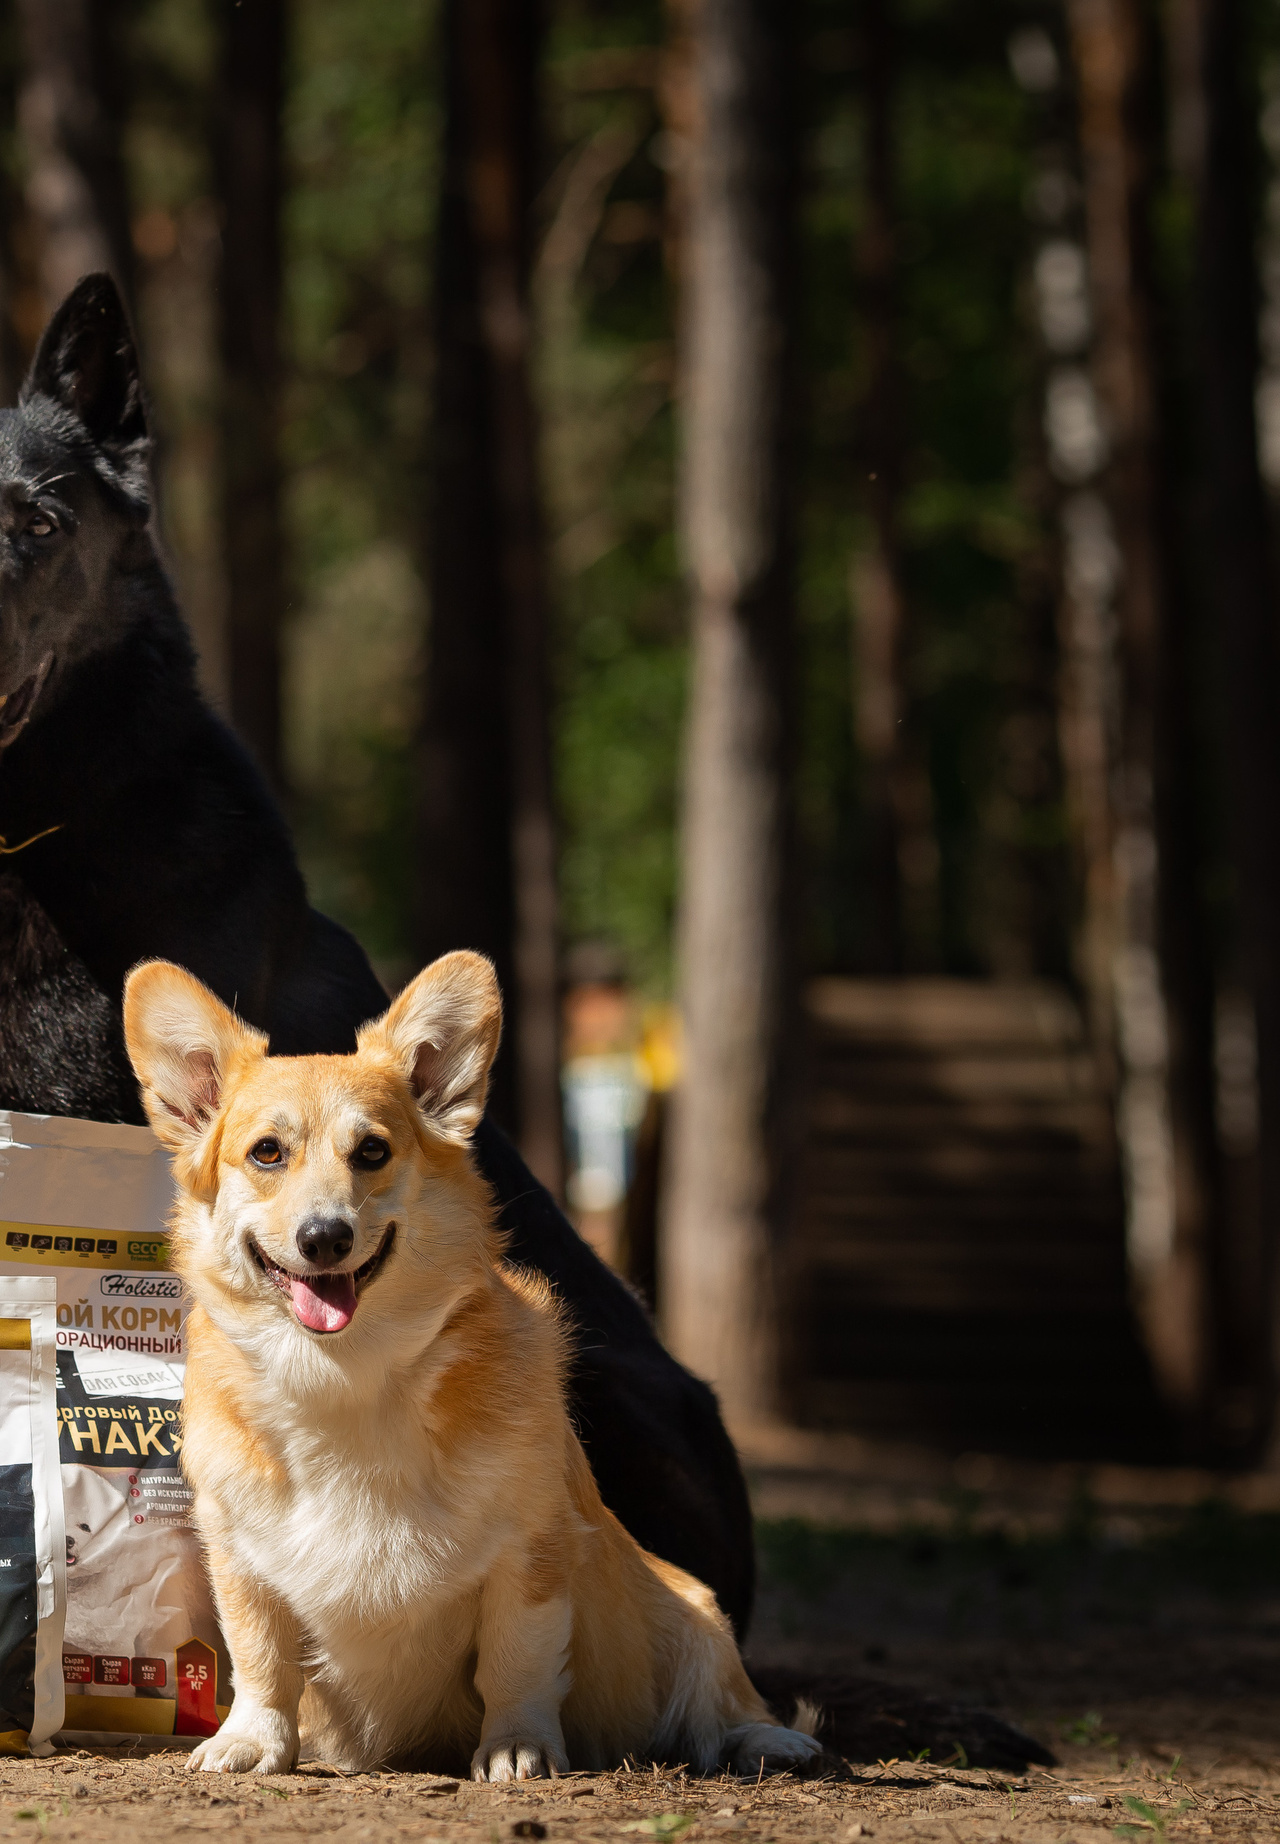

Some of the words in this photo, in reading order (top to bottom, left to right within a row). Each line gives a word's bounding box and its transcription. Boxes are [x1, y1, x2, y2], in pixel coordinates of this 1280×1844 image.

[130, 1242, 159, 1255] eco
[105, 1274, 179, 1298] Holistic
[101, 1305, 182, 1333] КОРМ
[84, 1375, 116, 1391] ДЛЯ
[117, 1370, 170, 1387] СОБАК
[143, 1488, 157, 1498] БЕЗ
[64, 1656, 84, 1665] Сырая
[101, 1658, 121, 1667] Сырая
[143, 1672, 155, 1680] 382
[185, 1663, 208, 1681] 2,5
